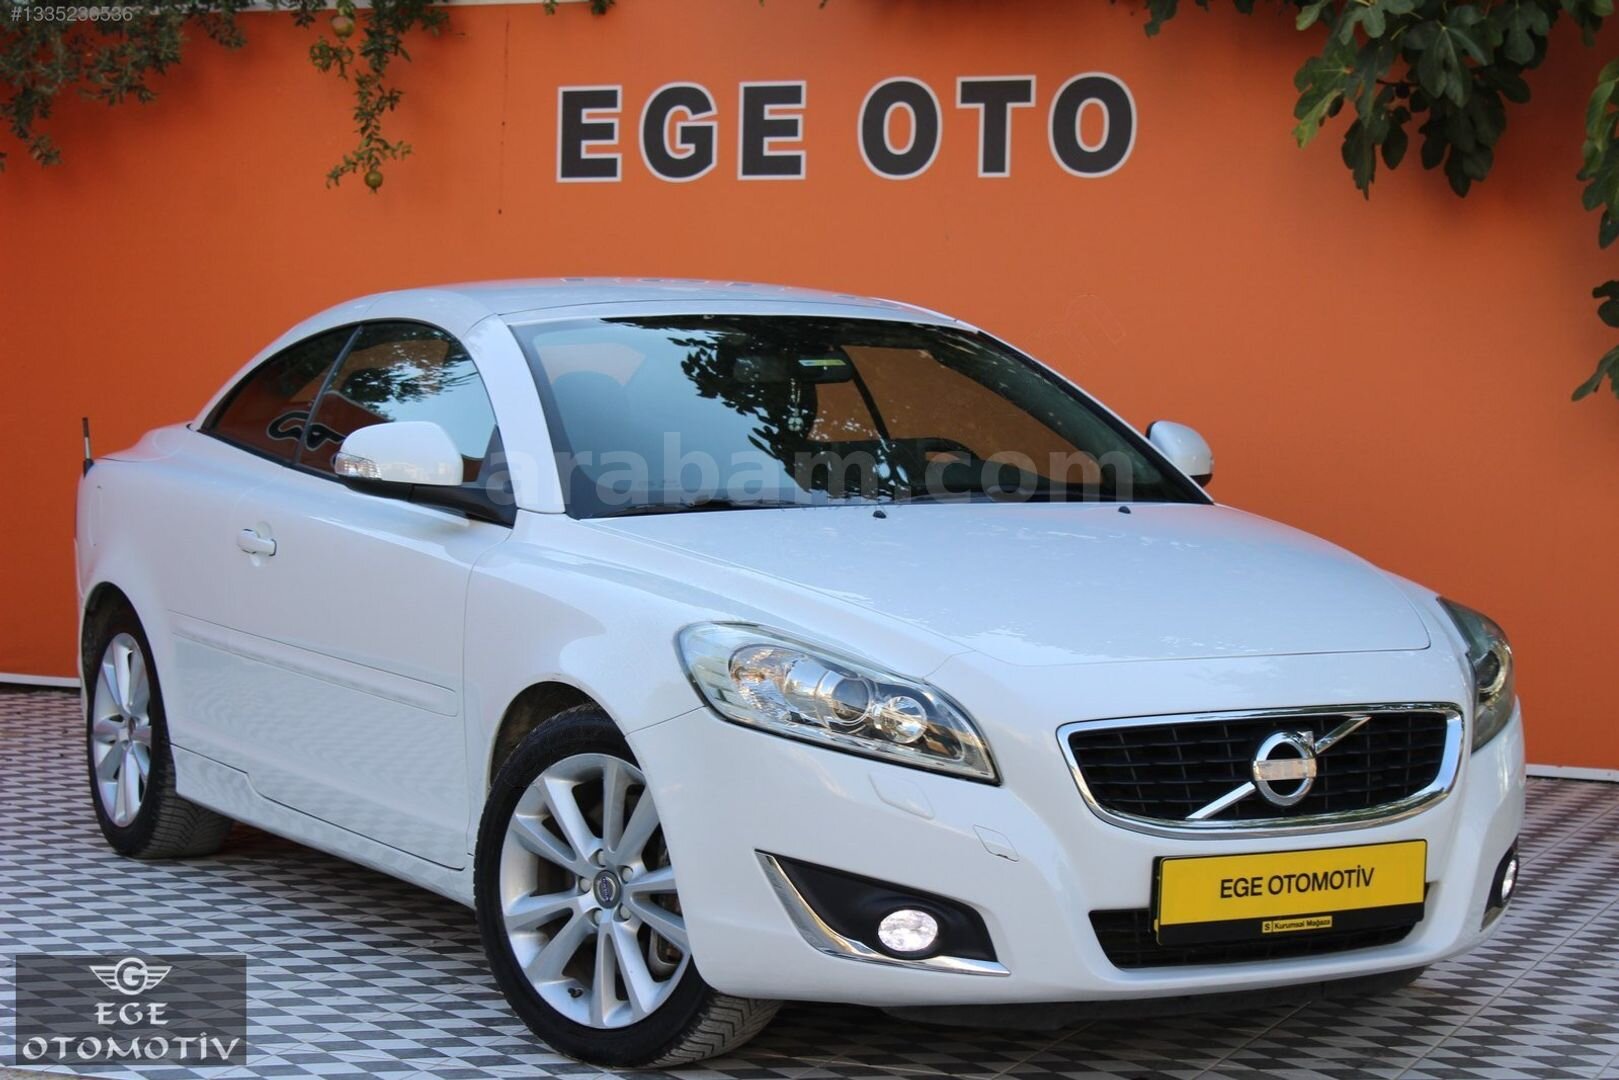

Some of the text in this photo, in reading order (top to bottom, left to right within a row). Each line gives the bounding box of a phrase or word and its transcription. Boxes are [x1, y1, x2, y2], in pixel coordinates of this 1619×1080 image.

[555, 72, 1137, 182] EGE OTO
[1220, 865, 1375, 899] EGE OTOMOTİV
